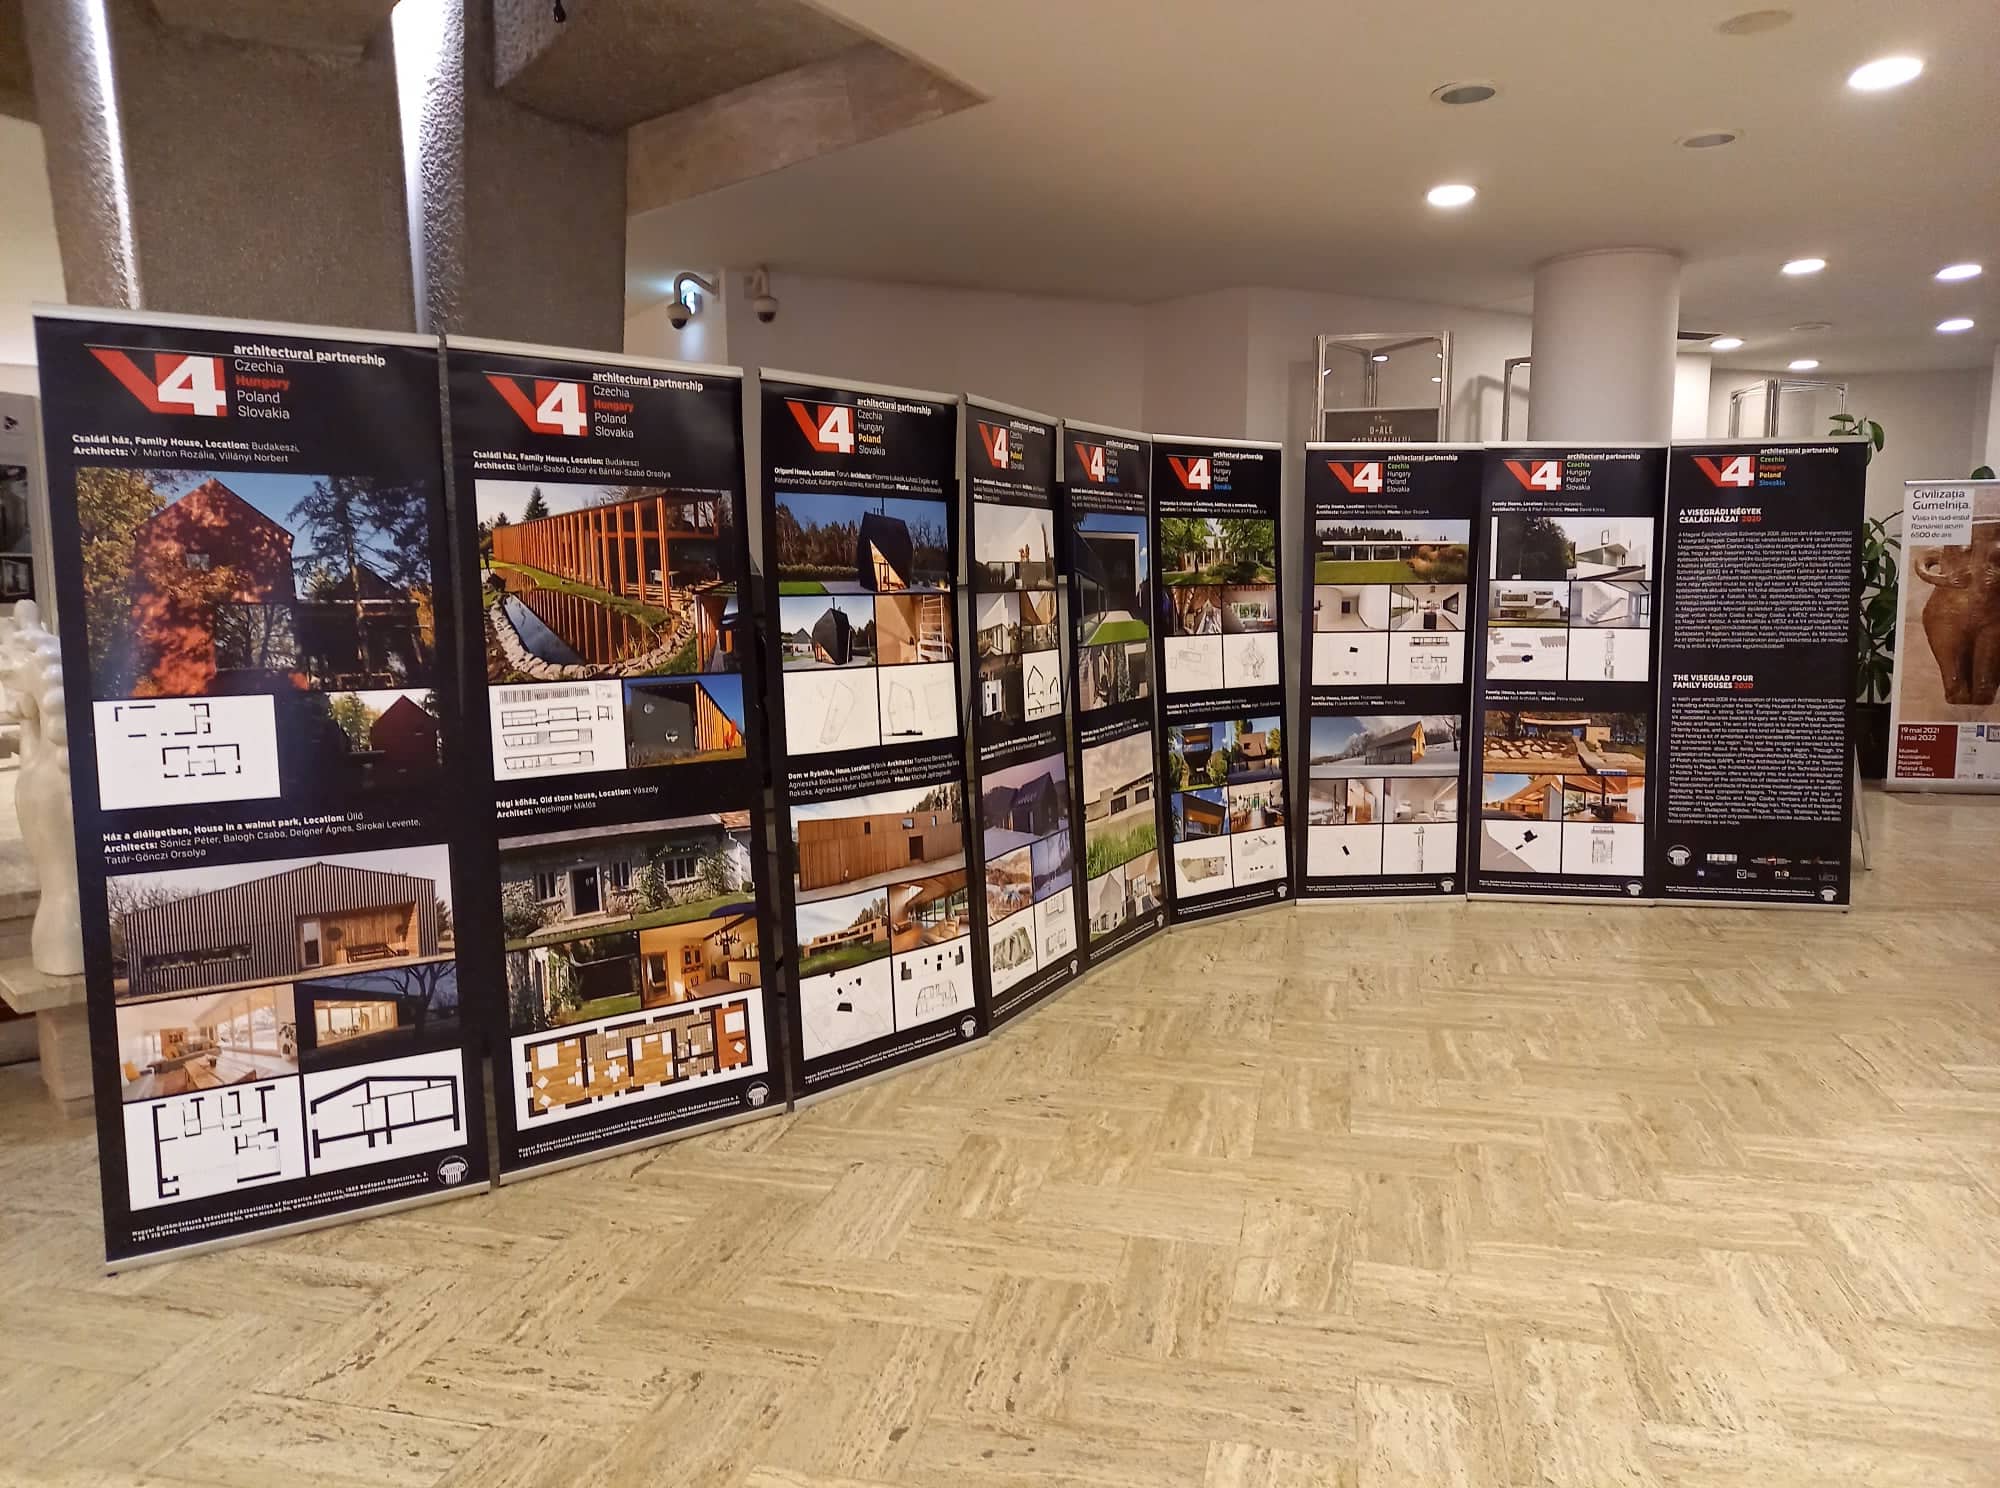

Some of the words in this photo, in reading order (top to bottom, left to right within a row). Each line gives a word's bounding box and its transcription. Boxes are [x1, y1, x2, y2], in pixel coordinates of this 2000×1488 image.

[234, 344, 313, 361] architectural
[317, 352, 386, 367] partnership
[234, 359, 284, 373] Czechia
[235, 375, 290, 390] Hungary
[593, 372, 651, 387] architectural
[653, 378, 703, 392] partnership
[237, 390, 280, 403] Poland
[593, 386, 629, 398] Czechia
[238, 405, 290, 419] Slovakia
[594, 400, 634, 412] Hungary
[857, 398, 896, 411] architectural
[898, 404, 931, 416] partnership
[595, 413, 626, 425] Poland
[858, 409, 882, 420] Czechia
[595, 426, 634, 438] Slovakia
[858, 422, 885, 434] Hungary
[72, 434, 109, 444] Családi
[112, 436, 133, 445] ház,
[135, 437, 167, 446] Family
[171, 438, 203, 449] House,
[205, 440, 248, 449] Location:
[859, 433, 881, 444] Poland
[73, 447, 128, 456] Architects:
[255, 454, 288, 462] Norbert
[859, 445, 885, 456] Slovakia
[473, 451, 501, 459] Családi
[503, 452, 518, 460] ház,
[520, 453, 543, 462] Family
[546, 454, 569, 463] House,
[571, 456, 603, 465] Location:
[1425, 454, 1458, 462] partnership
[474, 461, 515, 470] Architects:
[1914, 489, 1965, 500] Civilizația
[1688, 507, 1728, 515] VISEGRÁDI
[1730, 507, 1762, 515] NÉGYEK
[1913, 501, 1969, 511] Gumelnița
[1679, 515, 1712, 523] CSALÁDI
[540, 796, 552, 804] Old
[599, 789, 631, 798] Location:
[497, 809, 533, 818] Architect:
[103, 833, 122, 841] Ház
[194, 824, 223, 834] House
[226, 823, 235, 831] in
[245, 819, 276, 829] walnut
[278, 818, 301, 827] park,
[304, 815, 344, 825] Location:
[104, 843, 157, 853] Architects:
[194, 836, 221, 845] Péter,
[223, 833, 254, 842] Balogh
[387, 819, 421, 828] Levente,
[170, 849, 206, 859] Orsolya
